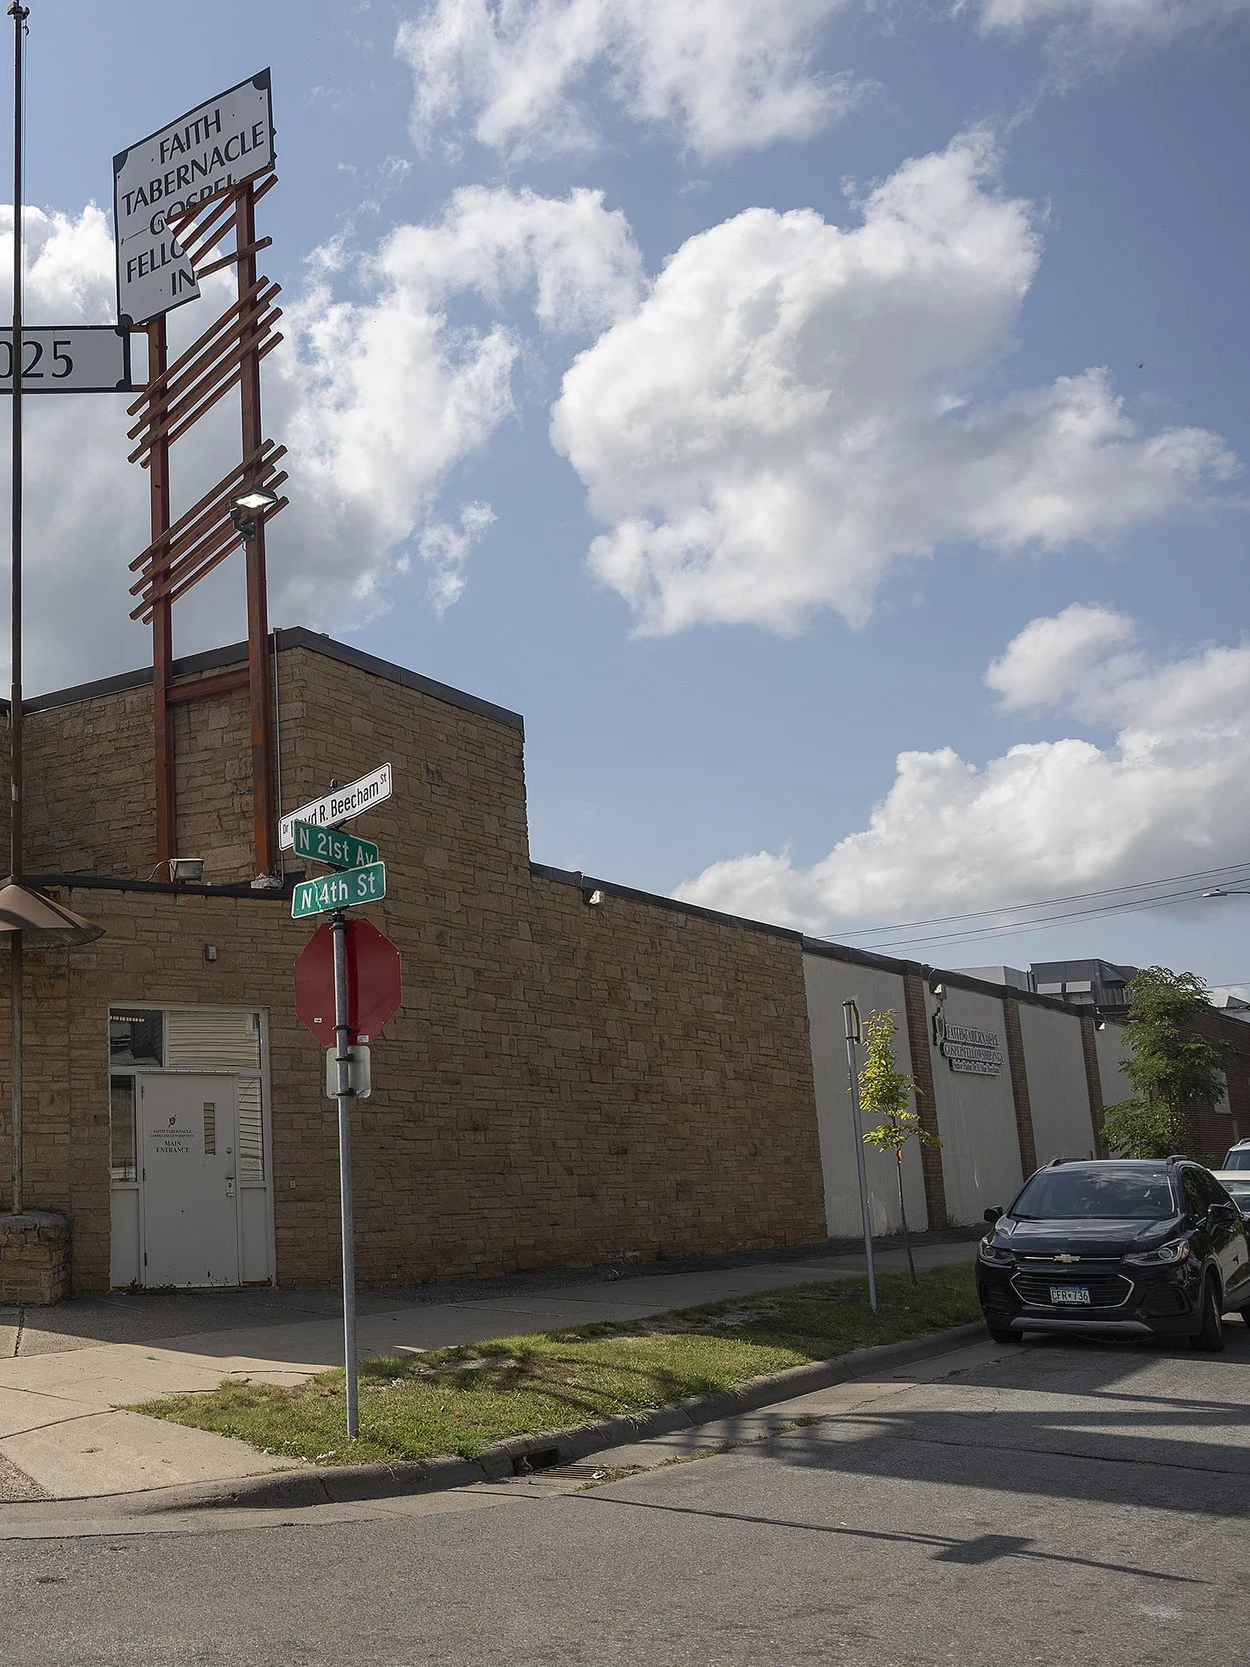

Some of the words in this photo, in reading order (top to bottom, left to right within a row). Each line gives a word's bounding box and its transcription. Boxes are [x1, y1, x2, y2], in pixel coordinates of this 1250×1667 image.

[159, 108, 221, 165] FAITH
[122, 120, 264, 217] TABERNACLE
[319, 804, 329, 823] R.
[331, 782, 379, 818] Beecham
[380, 772, 387, 785] St
[299, 827, 310, 851] N
[317, 832, 349, 862] 21st
[301, 887, 312, 910] N
[319, 879, 349, 904] 4th
[357, 871, 376, 897] St
[1051, 1290, 1067, 1300] CFR
[1072, 1291, 1089, 1300] 736
